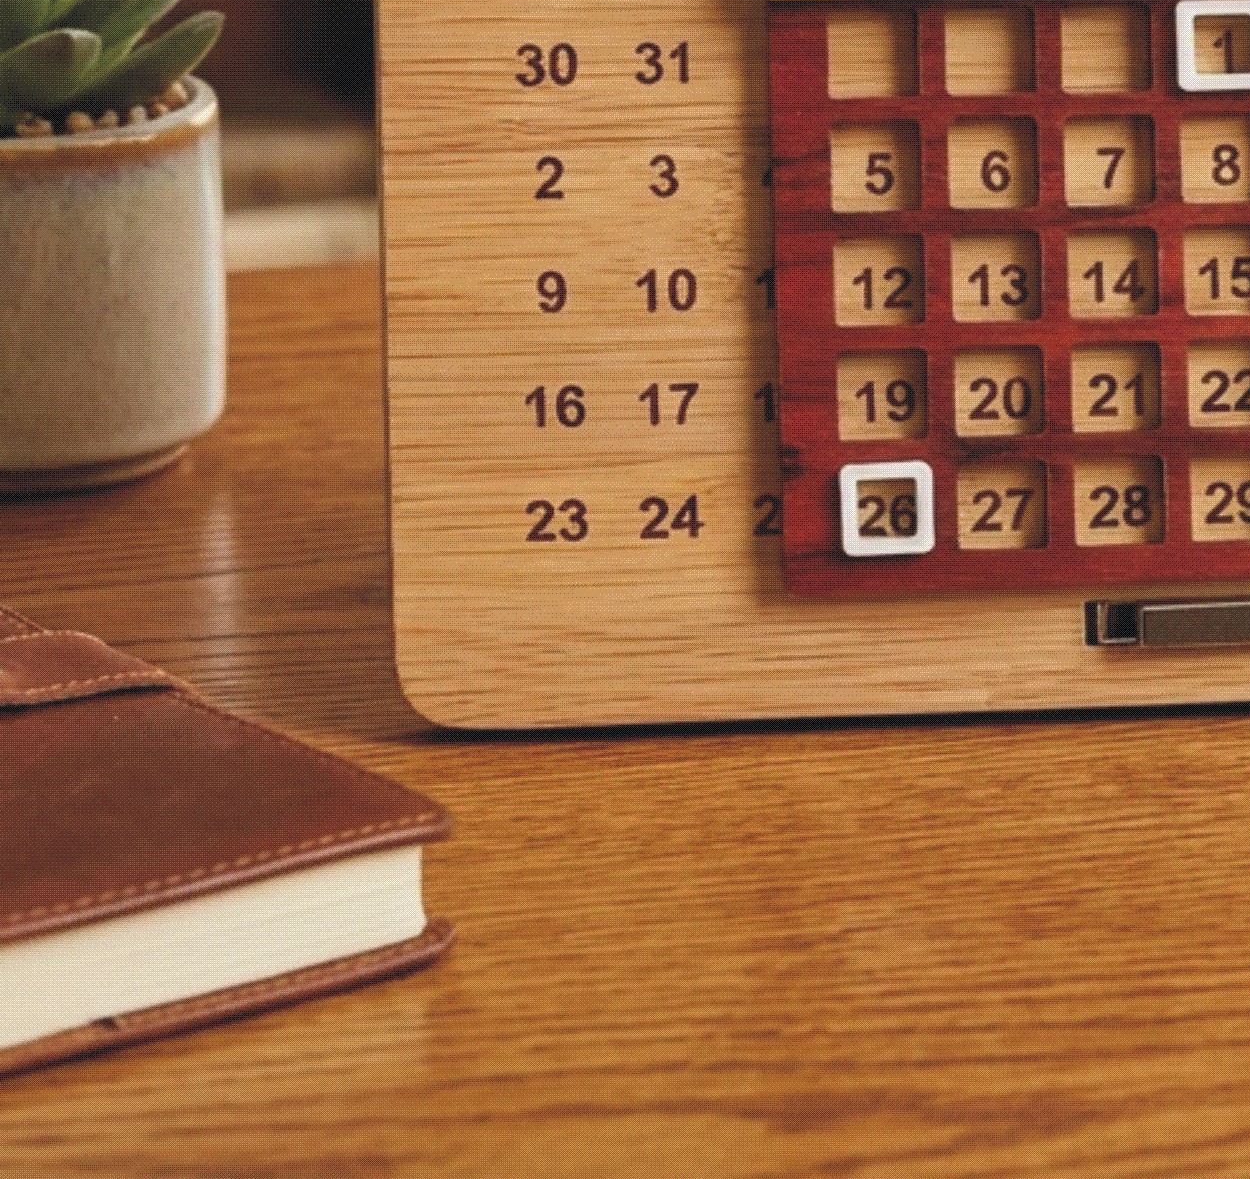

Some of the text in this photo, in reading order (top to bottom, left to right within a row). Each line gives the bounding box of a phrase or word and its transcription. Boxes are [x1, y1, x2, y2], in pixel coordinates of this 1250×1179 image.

[514, 42, 578, 86] 30
[634, 41, 691, 84] 31
[1209, 27, 1238, 75] 1
[534, 156, 565, 199] 2
[648, 154, 679, 197] 3
[865, 153, 894, 194] 5
[980, 150, 1011, 192] 6
[1097, 148, 1126, 189] 7
[1211, 142, 1241, 186] 8
[536, 270, 567, 313] 9
[635, 268, 698, 312] 10
[756, 268, 776, 308] 1
[852, 266, 914, 311] 12
[968, 264, 1029, 307] 13
[1083, 260, 1145, 303] 14
[524, 384, 586, 428] 16
[639, 383, 700, 425] 17
[754, 382, 779, 422] 1
[855, 379, 916, 422] 19
[968, 377, 1032, 420] 20
[1088, 374, 1143, 417] 21
[525, 498, 589, 542] 23
[639, 495, 703, 539] 24
[753, 494, 780, 536] 2
[857, 493, 918, 537] 26
[971, 488, 1033, 532] 27
[1088, 485, 1151, 528] 28
